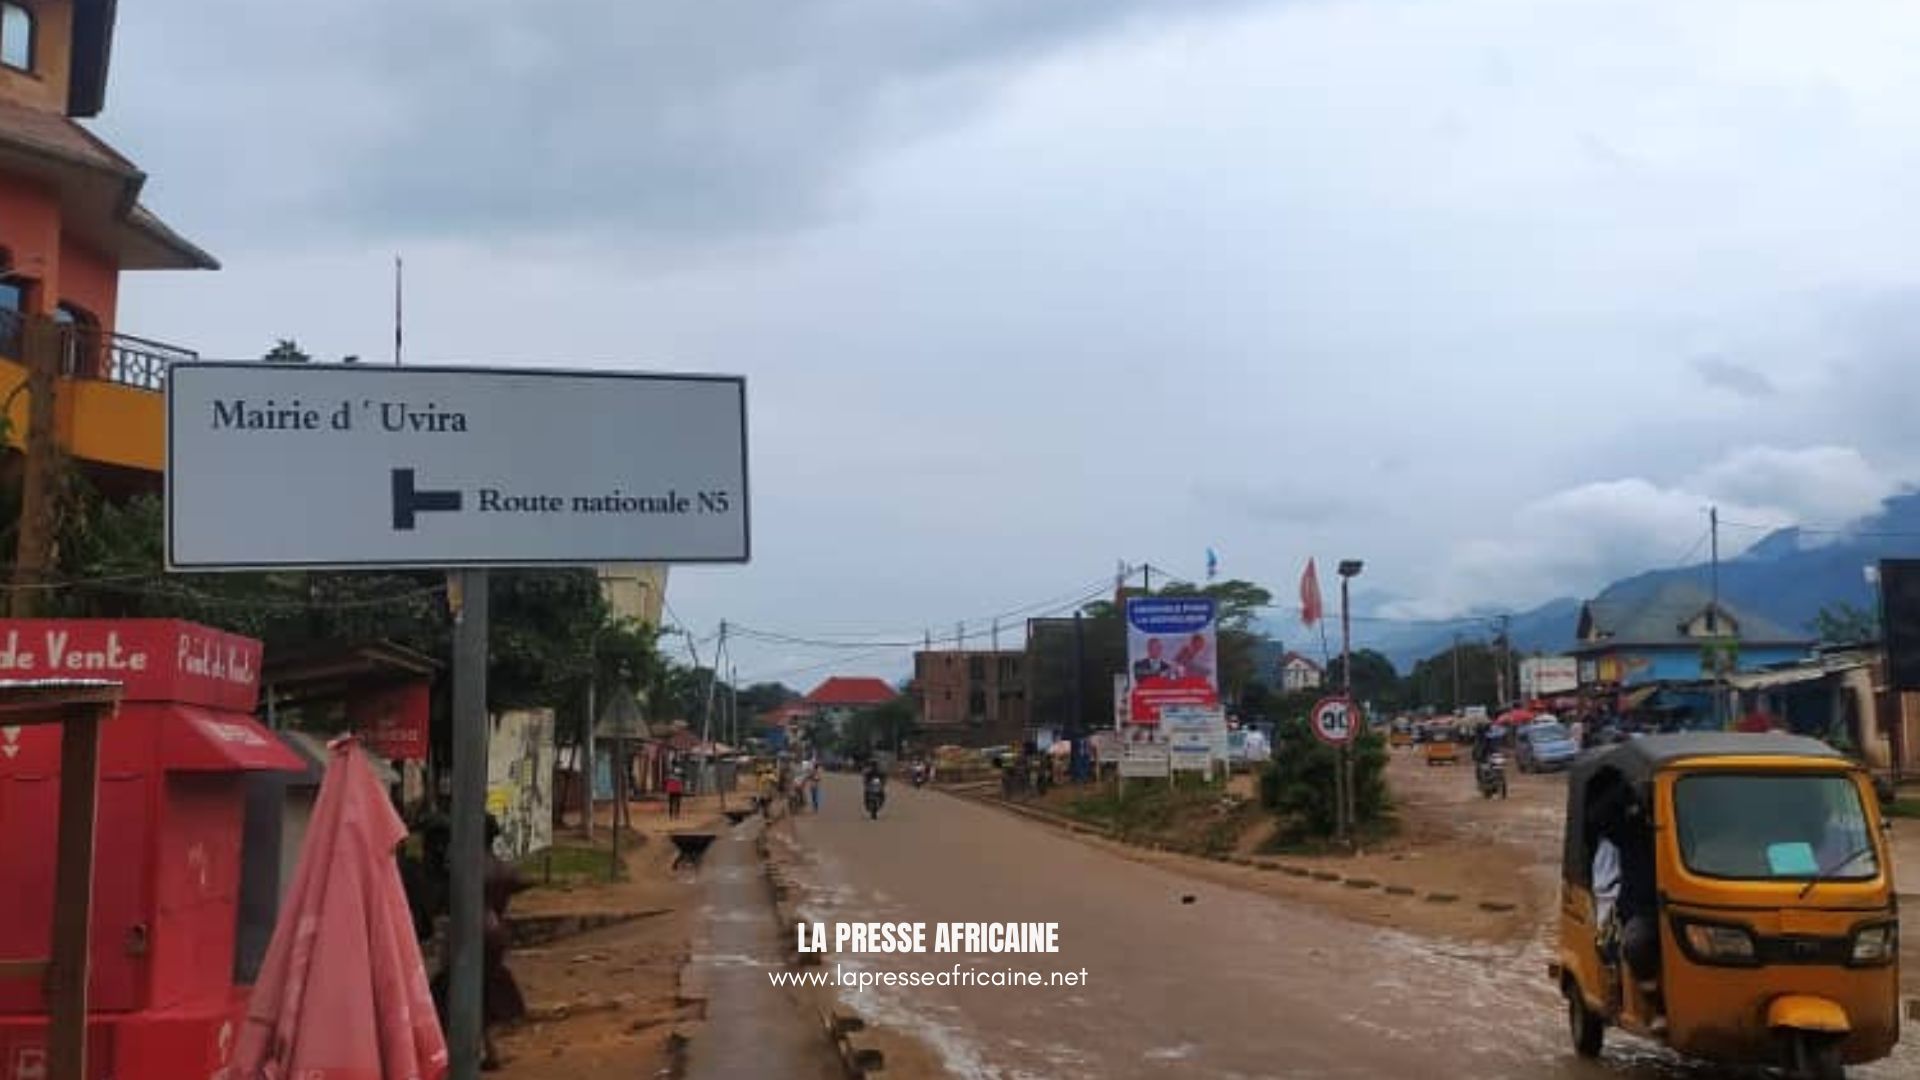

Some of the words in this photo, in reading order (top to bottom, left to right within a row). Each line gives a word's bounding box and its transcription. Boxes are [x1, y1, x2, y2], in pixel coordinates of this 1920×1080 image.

[212, 399, 320, 430] Mairie
[380, 402, 468, 432] Uvira
[478, 489, 564, 512] Route
[571, 489, 690, 514] nationale
[697, 491, 729, 513] N5
[46, 629, 148, 671] Vente
